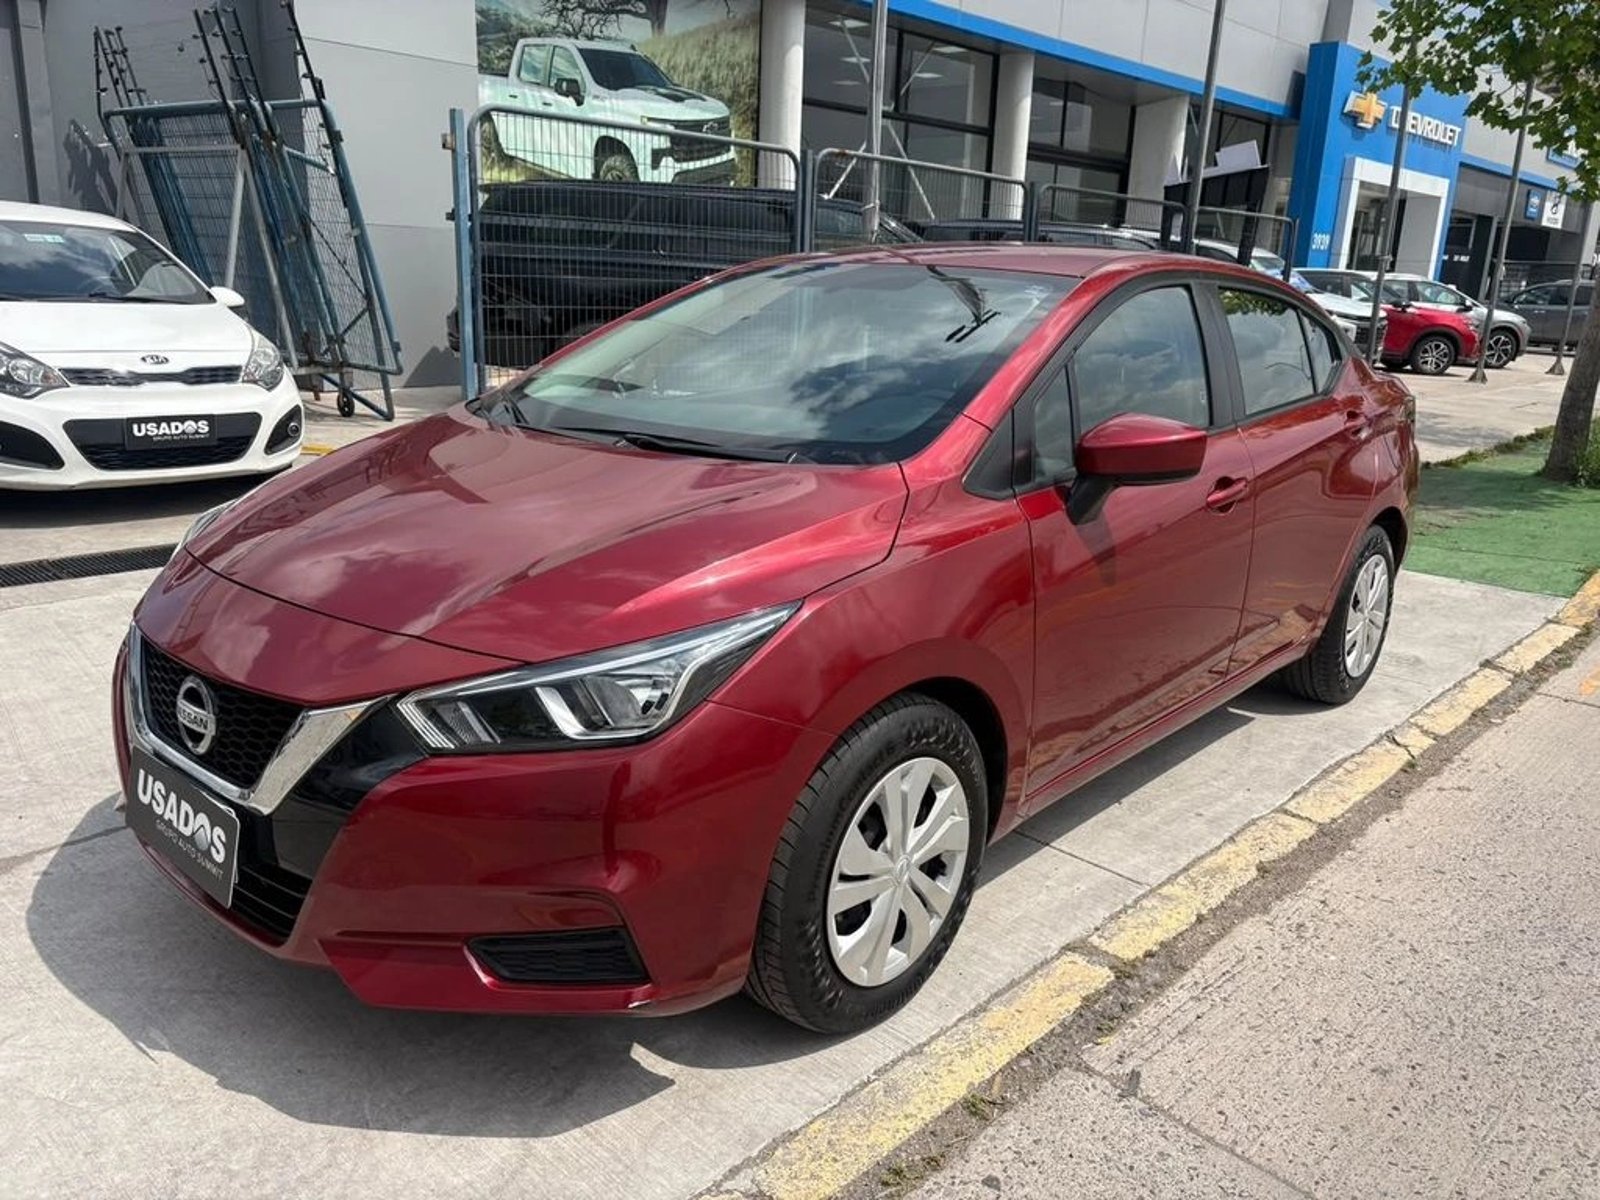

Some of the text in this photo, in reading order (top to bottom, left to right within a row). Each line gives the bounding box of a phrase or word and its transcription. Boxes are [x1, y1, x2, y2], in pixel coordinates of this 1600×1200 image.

[1390, 106, 1462, 147] CEVROLET
[132, 420, 210, 437] USADOS
[177, 706, 209, 731] NISSAN
[137, 768, 226, 863] USADOS
[155, 819, 224, 881] GRUPO AUTO SUMMIT
